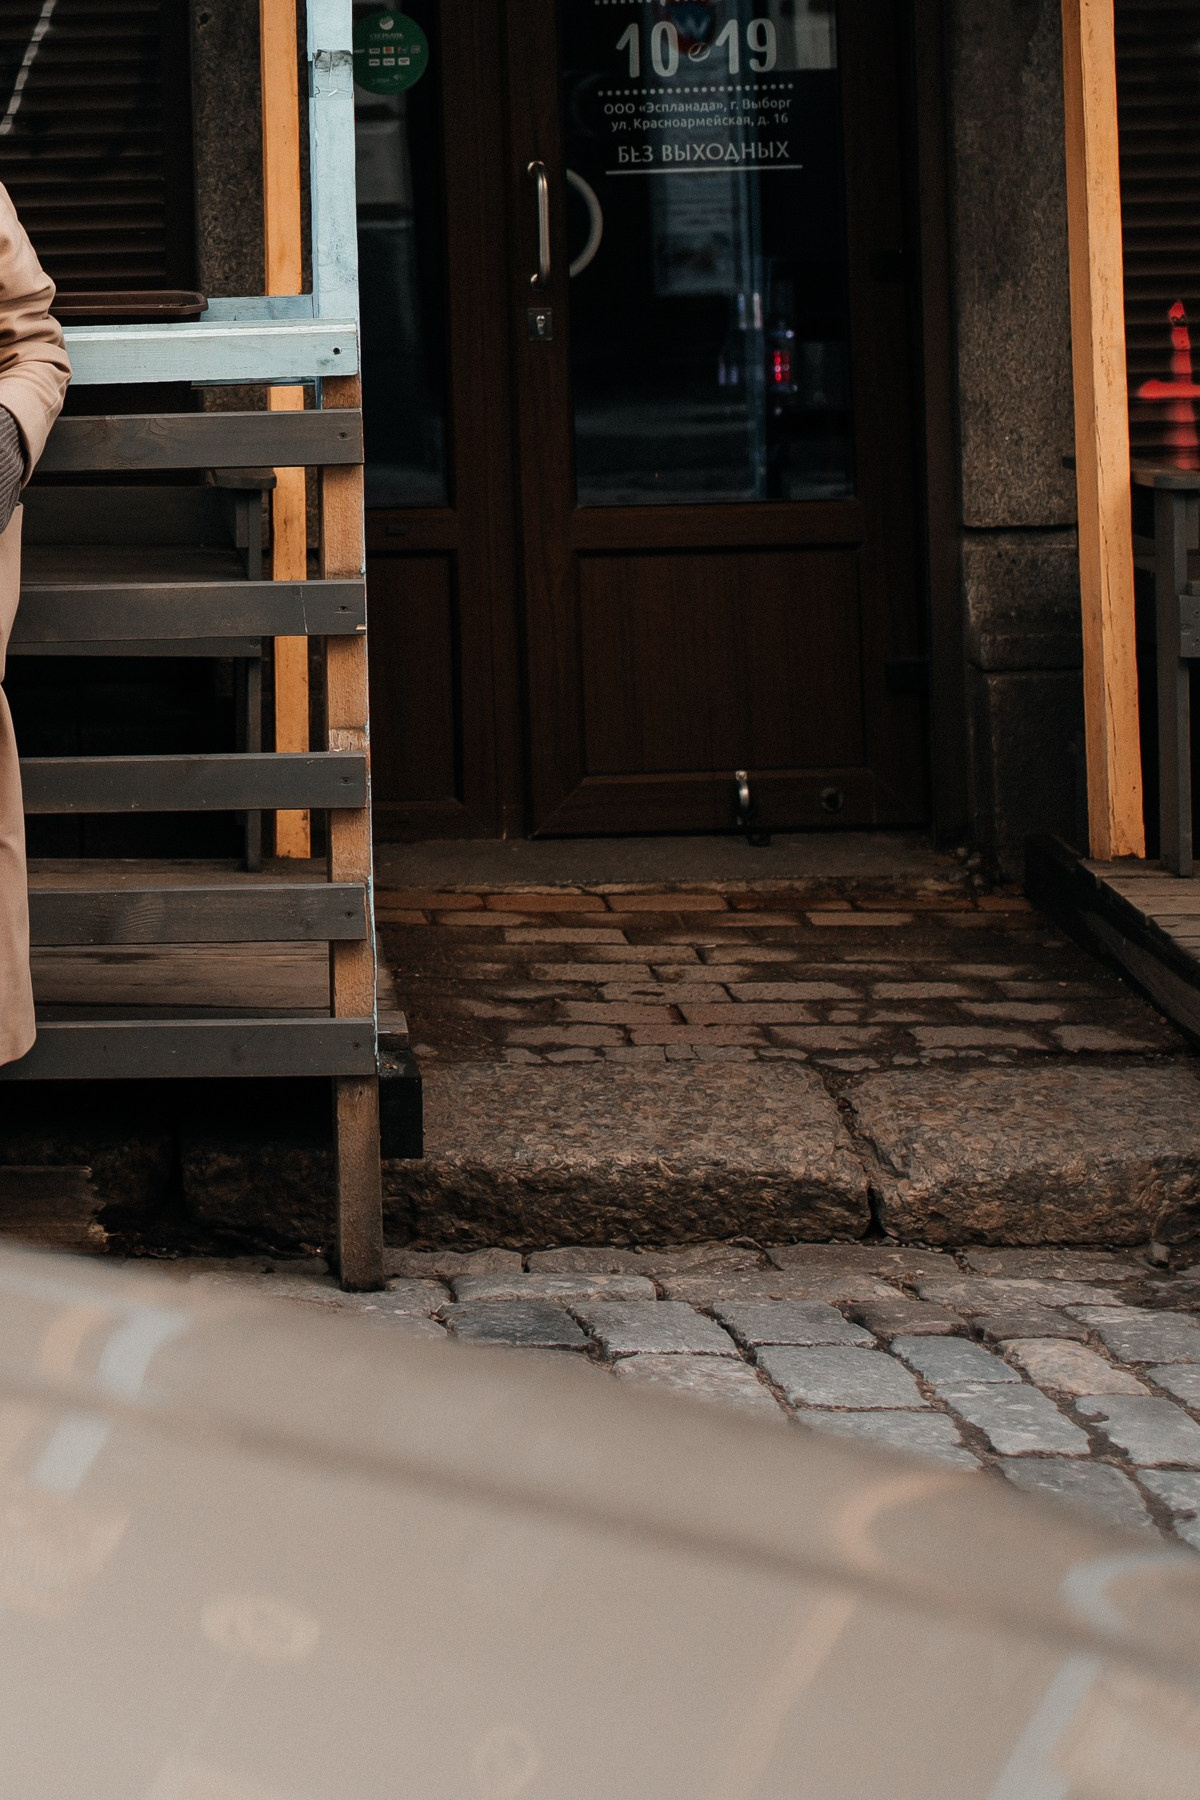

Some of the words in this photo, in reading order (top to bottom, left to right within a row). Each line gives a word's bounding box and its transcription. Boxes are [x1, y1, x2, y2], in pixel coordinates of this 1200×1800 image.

[615, 21, 680, 78] 10
[715, 18, 777, 75] 19
[604, 103, 635, 114] ООО
[742, 97, 792, 111] Выборг
[633, 115, 755, 130] Красноармейская,
[774, 113, 788, 124] 16
[618, 145, 654, 163] БЕЗ
[662, 141, 790, 163] ВЫХОДНЫХ
